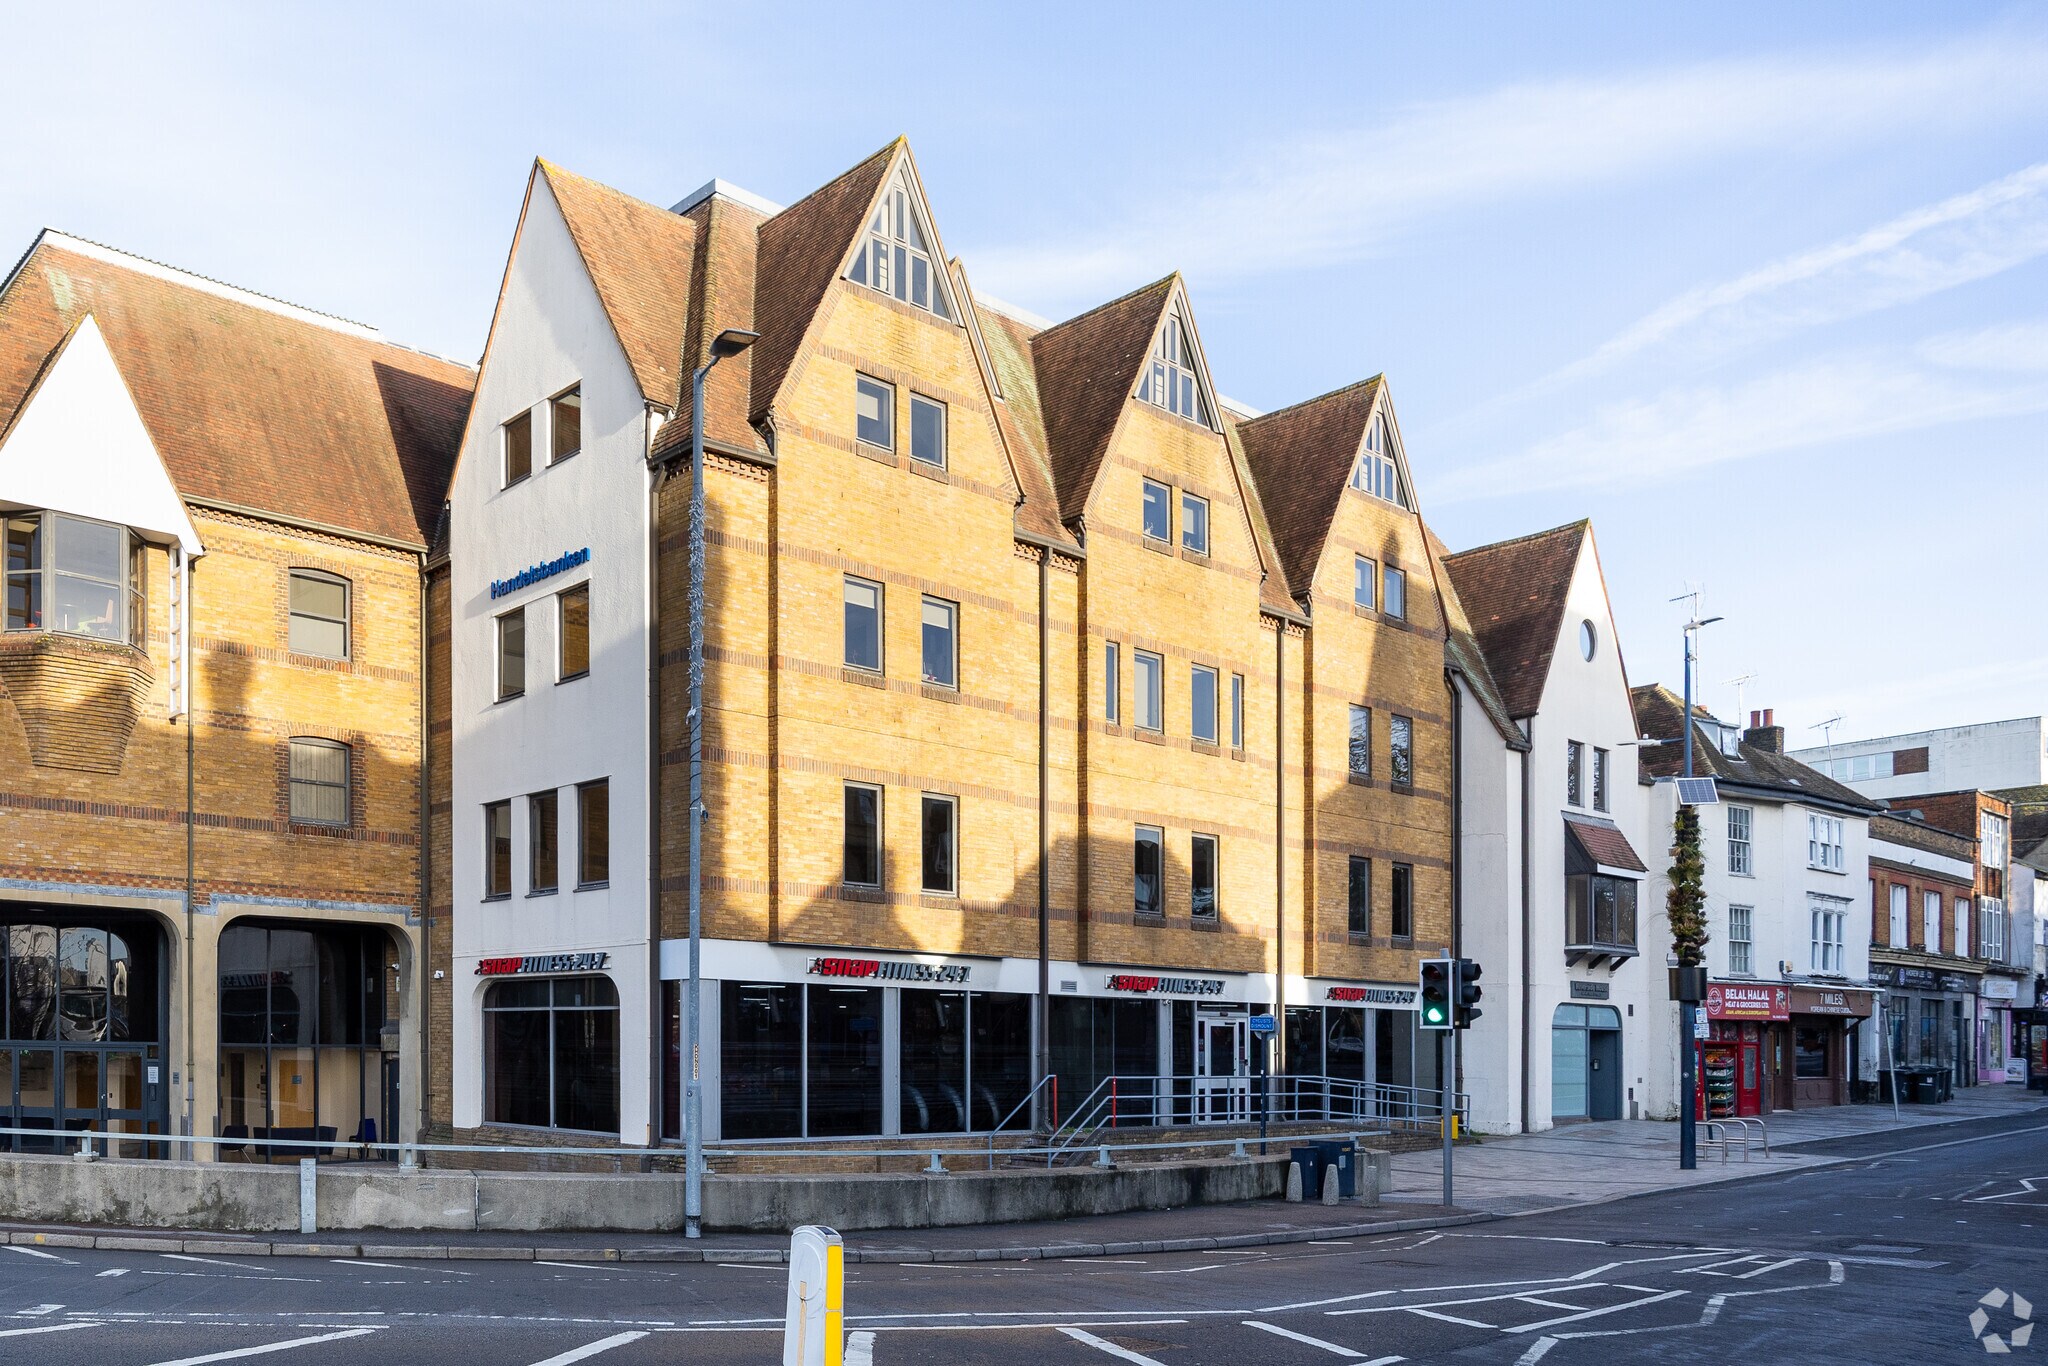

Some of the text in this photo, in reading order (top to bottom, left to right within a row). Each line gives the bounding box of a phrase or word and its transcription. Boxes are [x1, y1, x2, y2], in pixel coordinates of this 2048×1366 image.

[491, 547, 590, 600] Handelsbanken
[1725, 988, 1769, 1001] BELAL HALAL
[1820, 993, 1843, 1005] 7 MILES
[1725, 1000, 1736, 1008] MEAT
